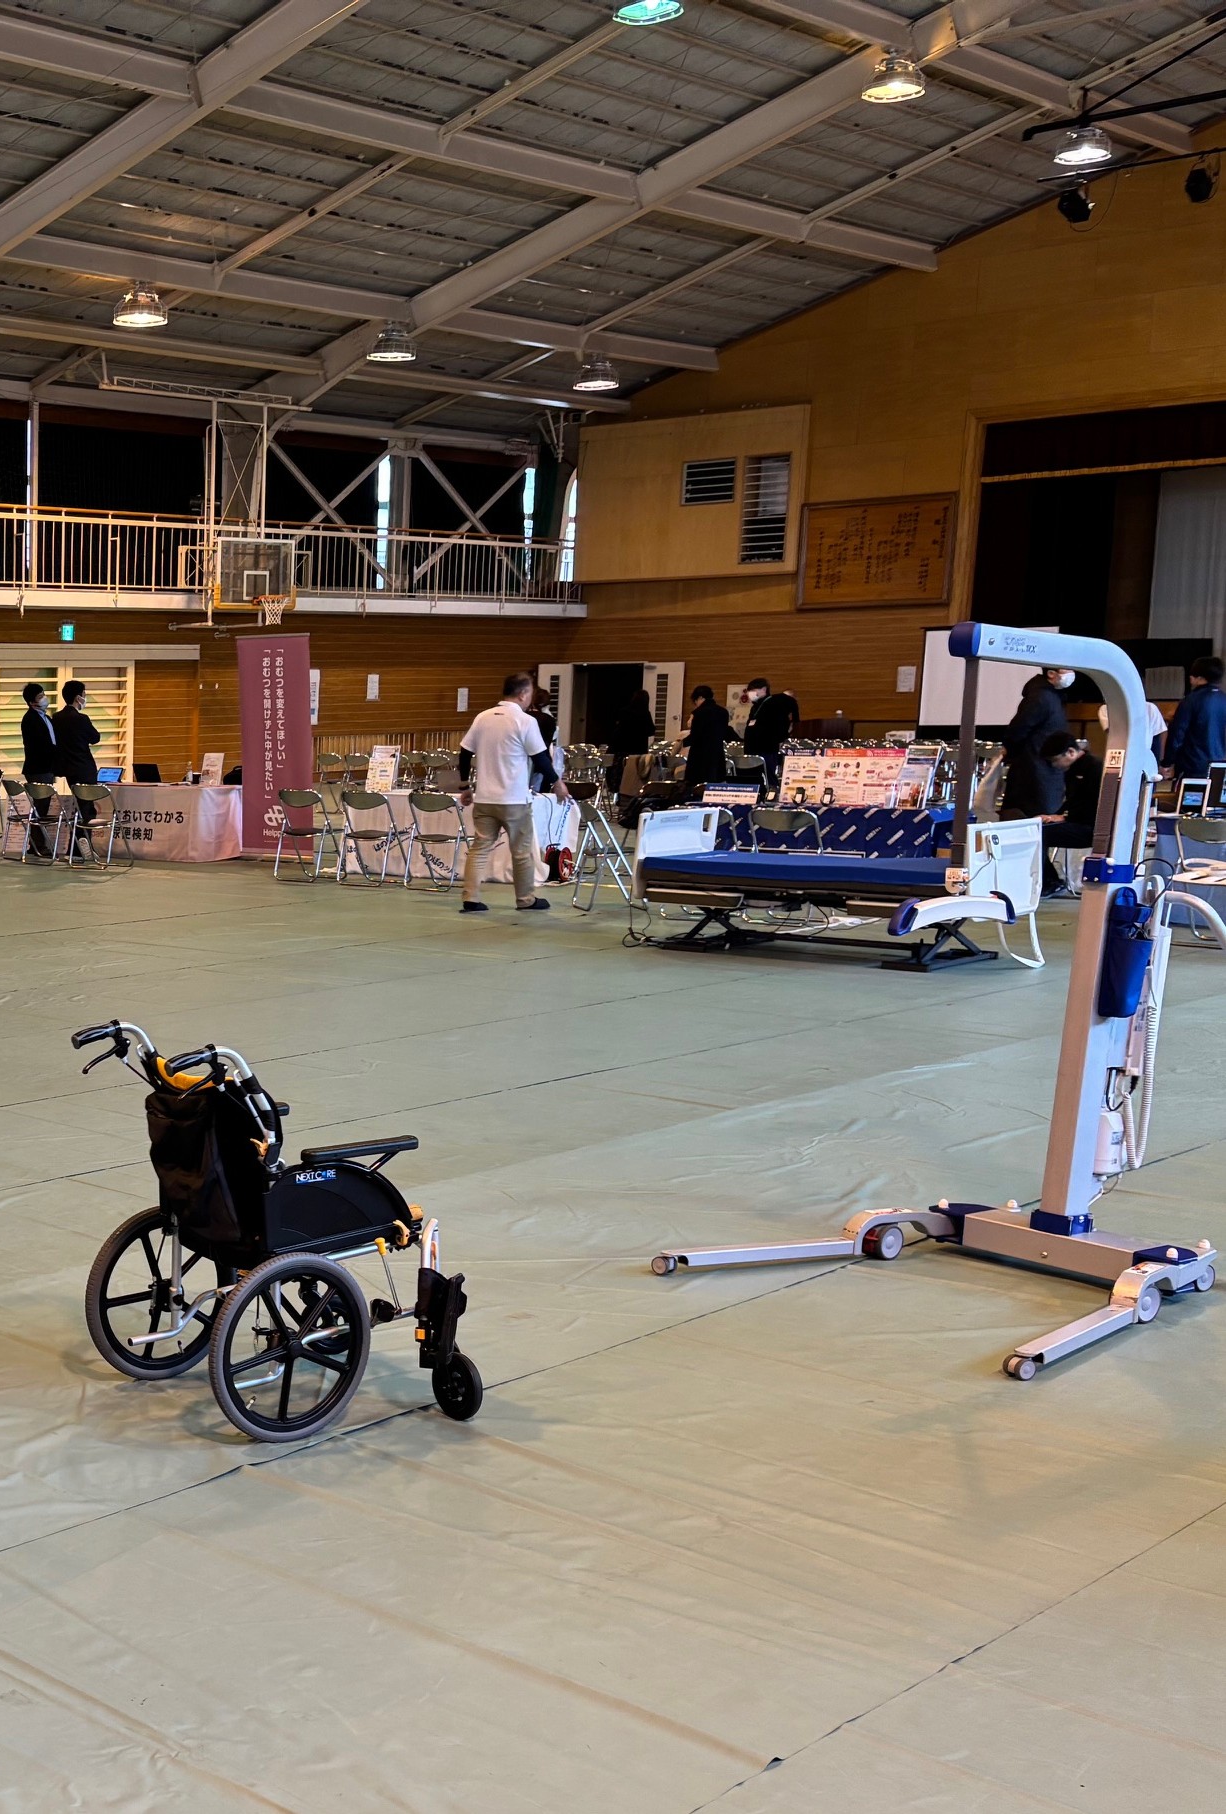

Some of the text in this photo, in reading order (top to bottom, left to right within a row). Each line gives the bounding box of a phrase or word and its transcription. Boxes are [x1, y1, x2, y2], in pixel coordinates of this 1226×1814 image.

[262, 649, 274, 799] 「おむつを開けずに中が見たい」
[275, 648, 286, 769] 「おむつを変えてほしい」
